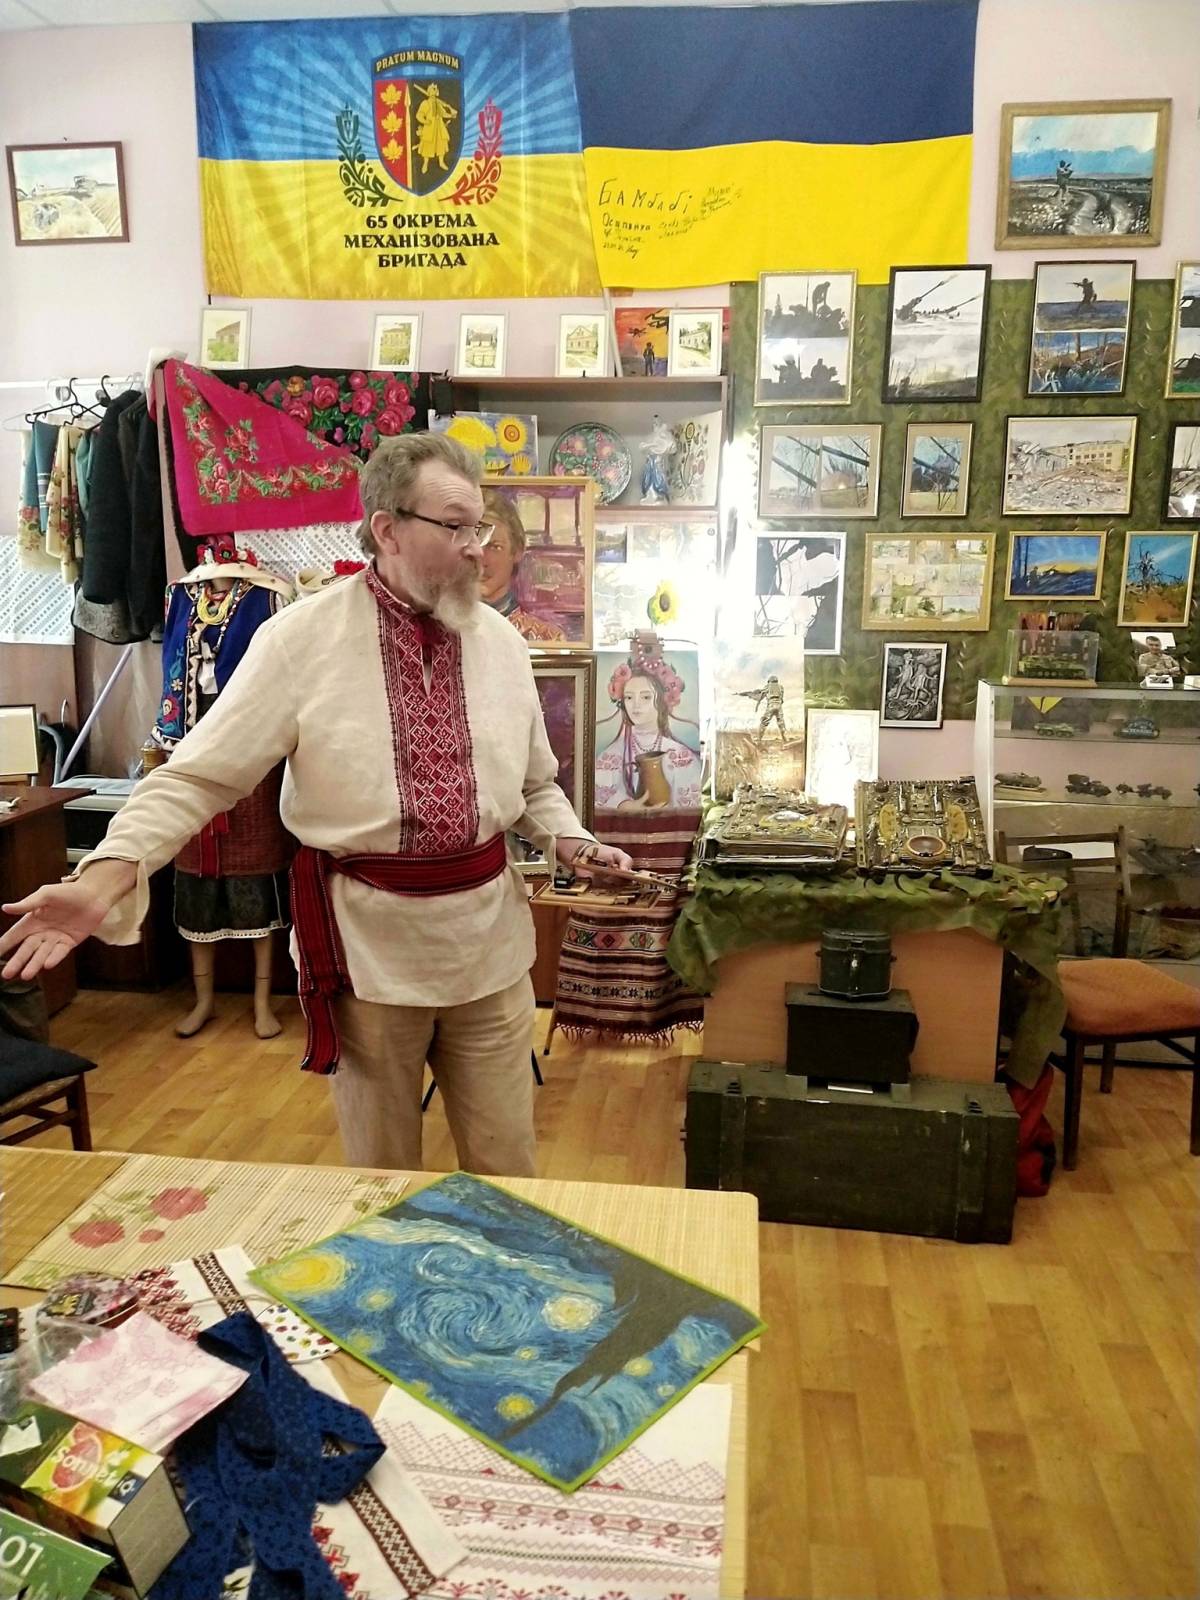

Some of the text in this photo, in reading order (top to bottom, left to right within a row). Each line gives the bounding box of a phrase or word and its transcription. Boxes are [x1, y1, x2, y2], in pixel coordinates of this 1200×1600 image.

[376, 50, 459, 73] PRATUM MAGNUM
[366, 213, 477, 229] 65 ОКРЕМА
[344, 231, 500, 249] МЕХАНІЗОВАНА
[377, 252, 467, 269] БРИГАДА
